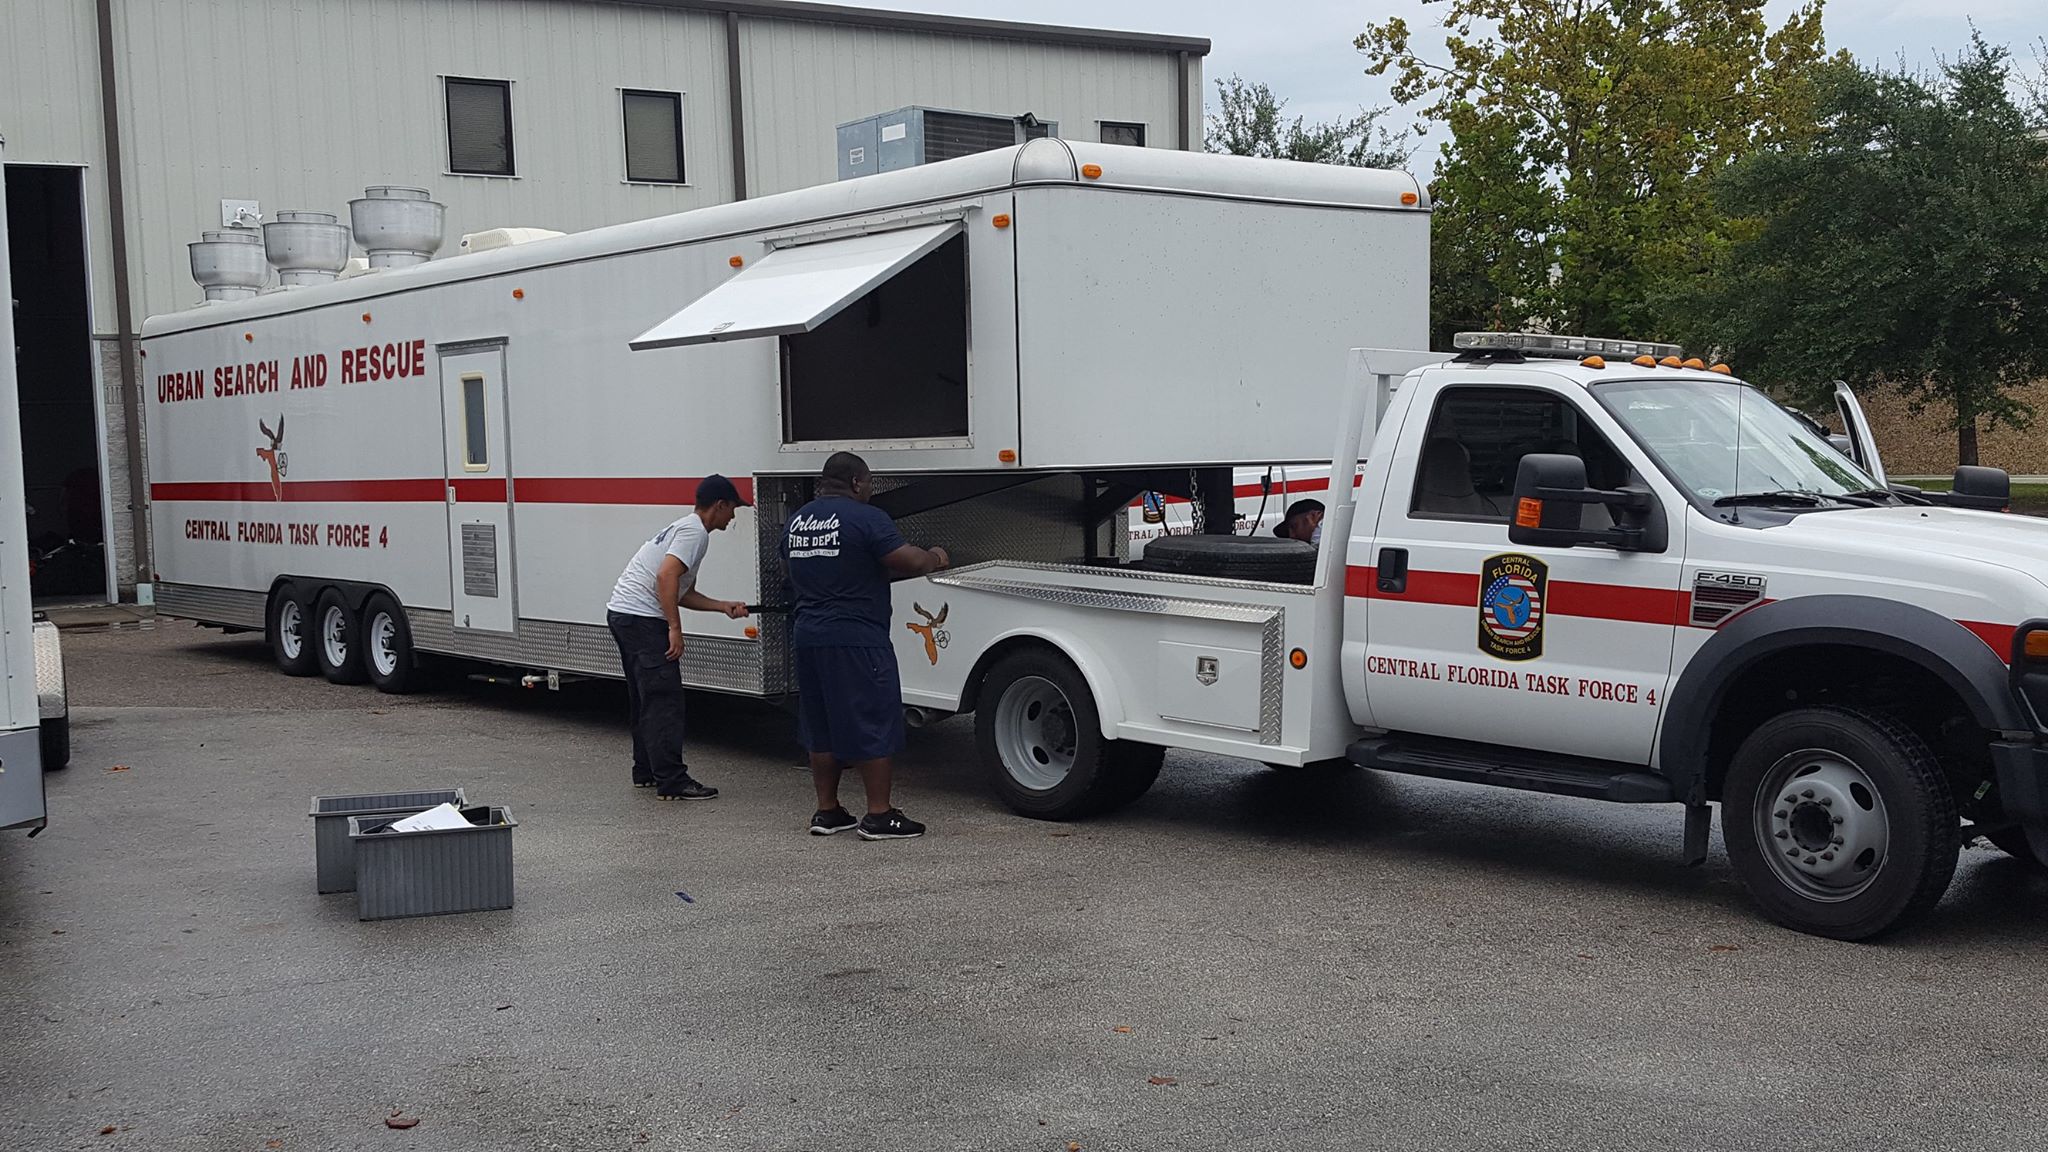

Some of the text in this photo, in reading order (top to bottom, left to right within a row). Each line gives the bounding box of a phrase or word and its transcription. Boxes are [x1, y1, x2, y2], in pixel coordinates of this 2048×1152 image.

[157, 339, 425, 404] URBAN SEARCH AND RESCUE
[790, 513, 840, 533] Orlando
[1128, 529, 1154, 540] TRAL
[1260, 520, 1265, 528] 4
[185, 519, 388, 548] CENTRAL FLORIDA TASK FORCE 4
[788, 530, 840, 548] FIRE DEPT.
[1501, 556, 1531, 567] CENTRAL
[1492, 564, 1538, 583] FLORIDA
[1697, 572, 1762, 586] F-450
[1490, 641, 1505, 653] TASK
[1505, 647, 1527, 655] FORCE
[1367, 655, 1657, 705] CENTRAL FLORIDA TASK FORCE 4
